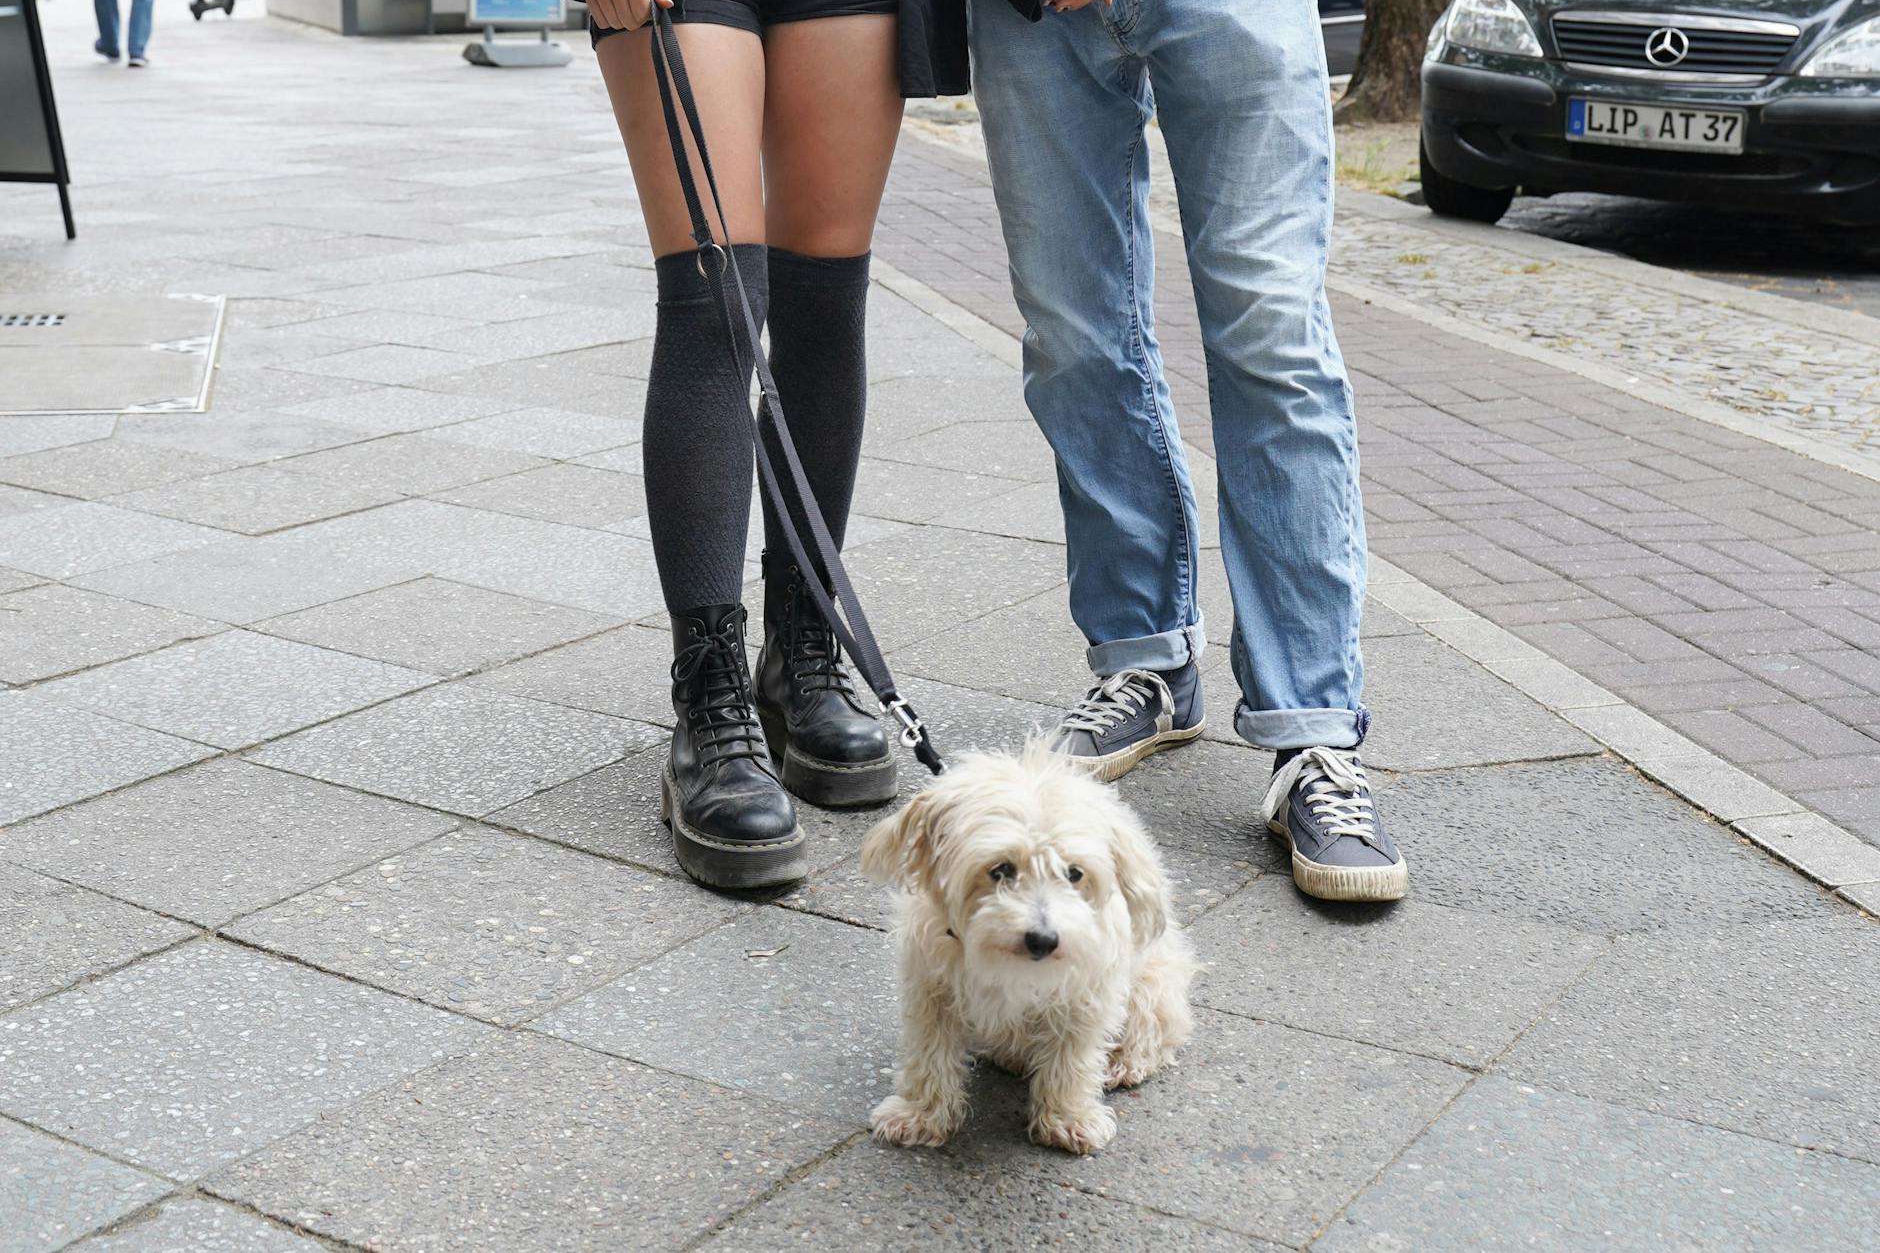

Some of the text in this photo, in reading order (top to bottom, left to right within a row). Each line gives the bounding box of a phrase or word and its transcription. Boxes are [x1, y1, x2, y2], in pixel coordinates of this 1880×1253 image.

[1587, 105, 1639, 135] LIP
[1658, 111, 1697, 140] AT
[1703, 114, 1739, 143] 37
